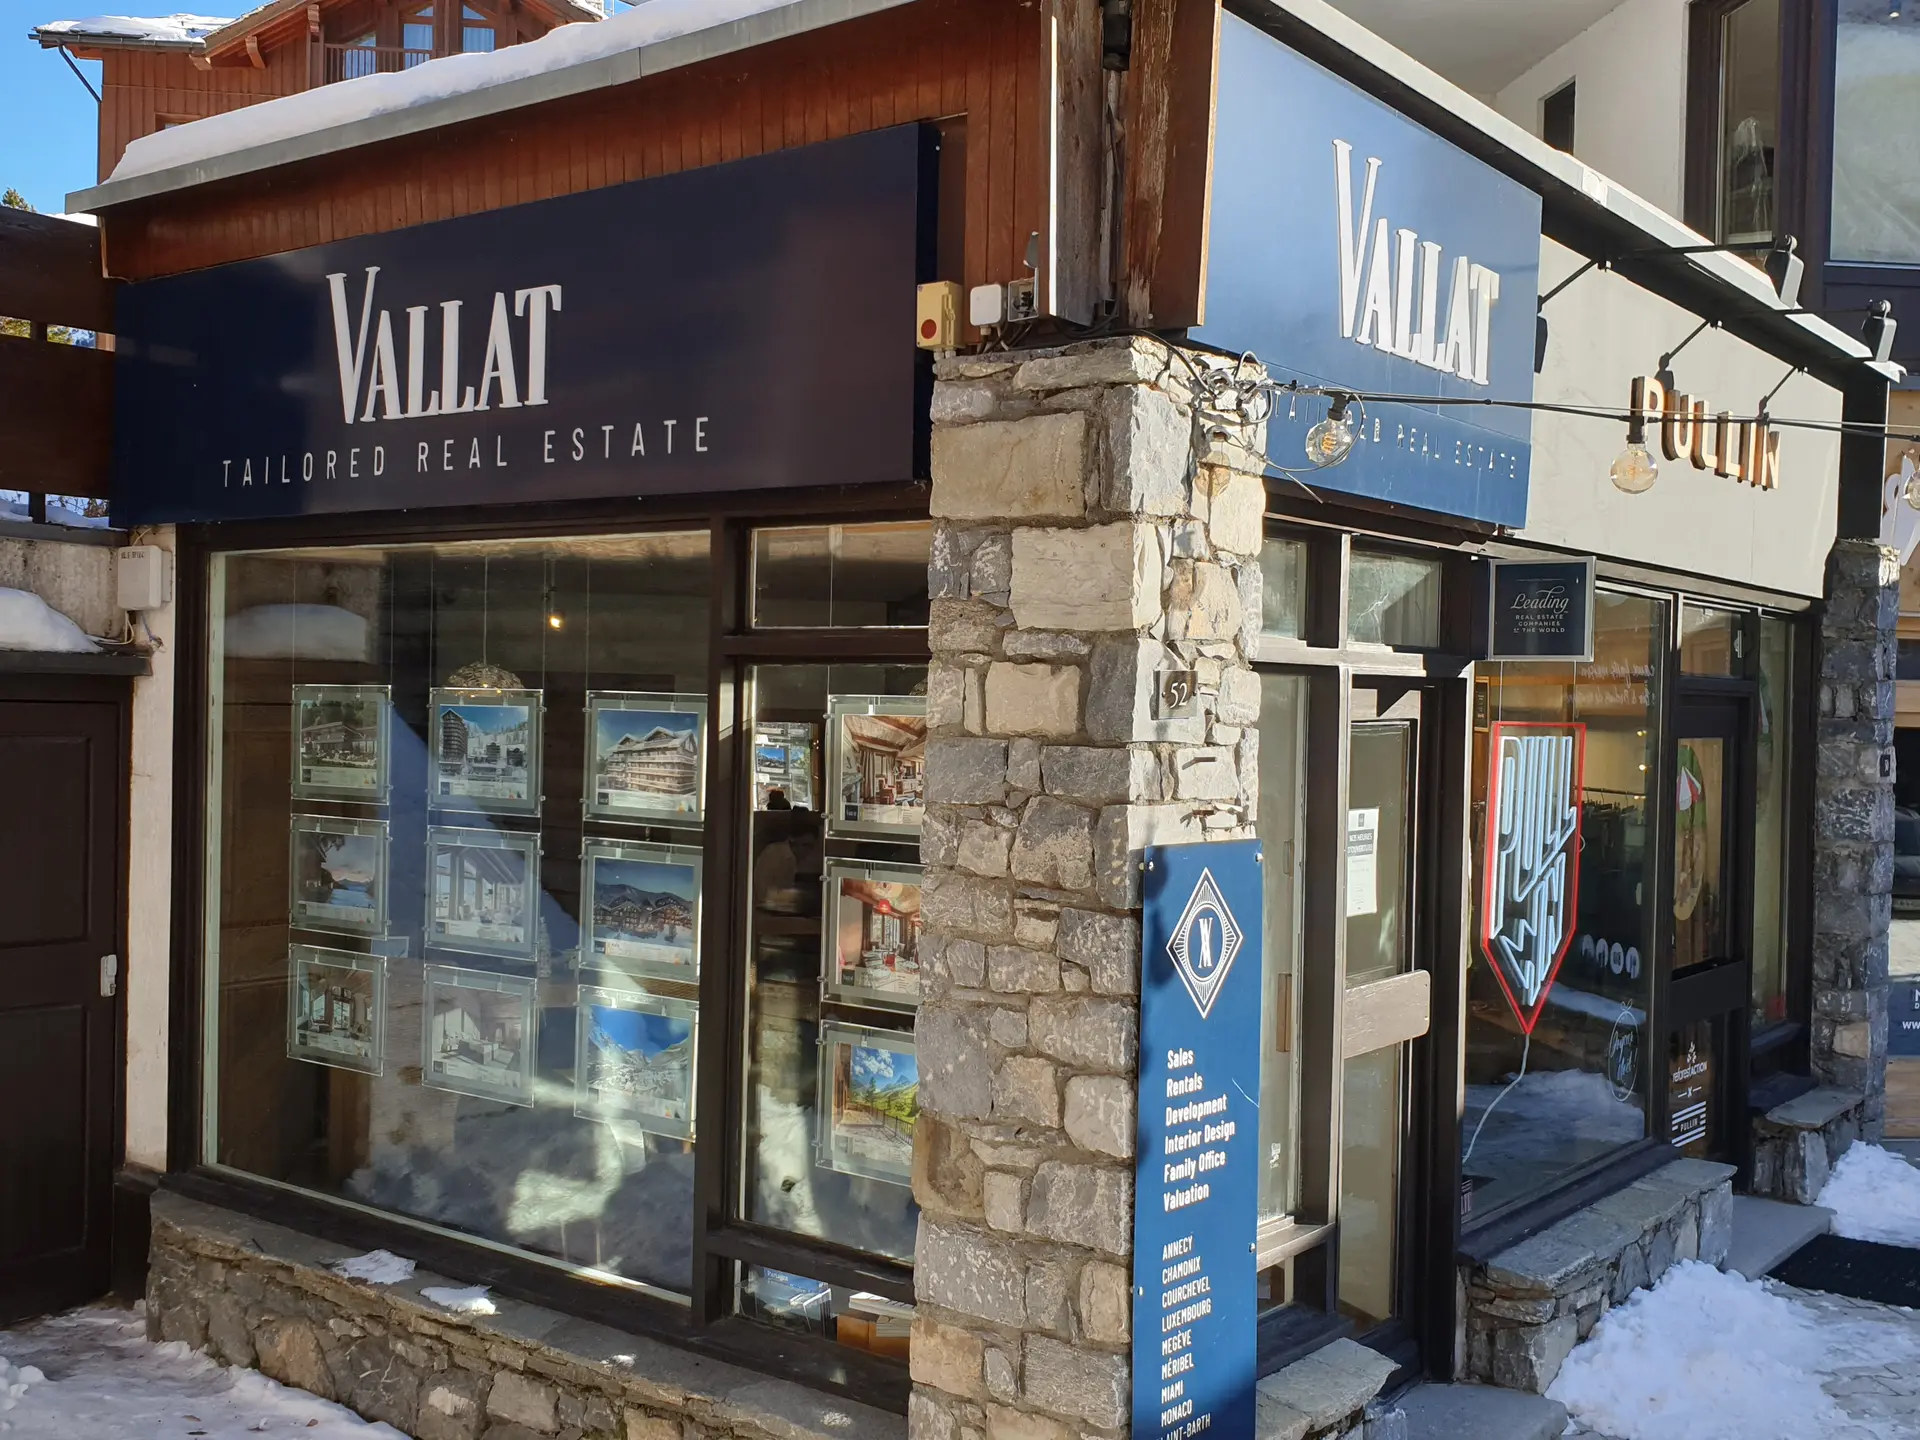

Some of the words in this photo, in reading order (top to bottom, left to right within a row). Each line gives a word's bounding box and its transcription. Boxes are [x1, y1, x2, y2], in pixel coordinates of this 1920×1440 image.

[1332, 138, 1499, 386] VALLAT
[326, 266, 562, 424] VALLAT
[1631, 376, 1780, 491] PULLIN
[223, 446, 385, 487] TAILORED
[417, 435, 508, 473] REAL
[544, 416, 709, 464] ESTATE
[1398, 424, 1440, 459] REAL
[1455, 440, 1516, 479] ESTATE
[1510, 586, 1569, 614] Leading
[1169, 682, 1188, 709] 52
[1167, 1047, 1194, 1069] Sales
[1166, 1072, 1203, 1098] Rentals
[1165, 1094, 1226, 1126] Development
[1680, 1116, 1698, 1132] PULLIN
[1165, 1129, 1202, 1155] Interior
[1204, 1119, 1235, 1143] Design
[1164, 1157, 1196, 1184] Family
[1198, 1149, 1226, 1172] Office
[1163, 1183, 1210, 1213] Valuation
[1162, 1235, 1193, 1261] ANNECY
[1162, 1256, 1201, 1284] CHAMONIX
[1162, 1276, 1210, 1308] COURCHEVEL
[1162, 1298, 1211, 1332] LUXEMBOURG
[1161, 1330, 1191, 1356] MEGÈVE
[1161, 1352, 1194, 1380] MÉRIBEL
[1161, 1380, 1184, 1404] MIAMI
[1161, 1399, 1192, 1427] MONACO
